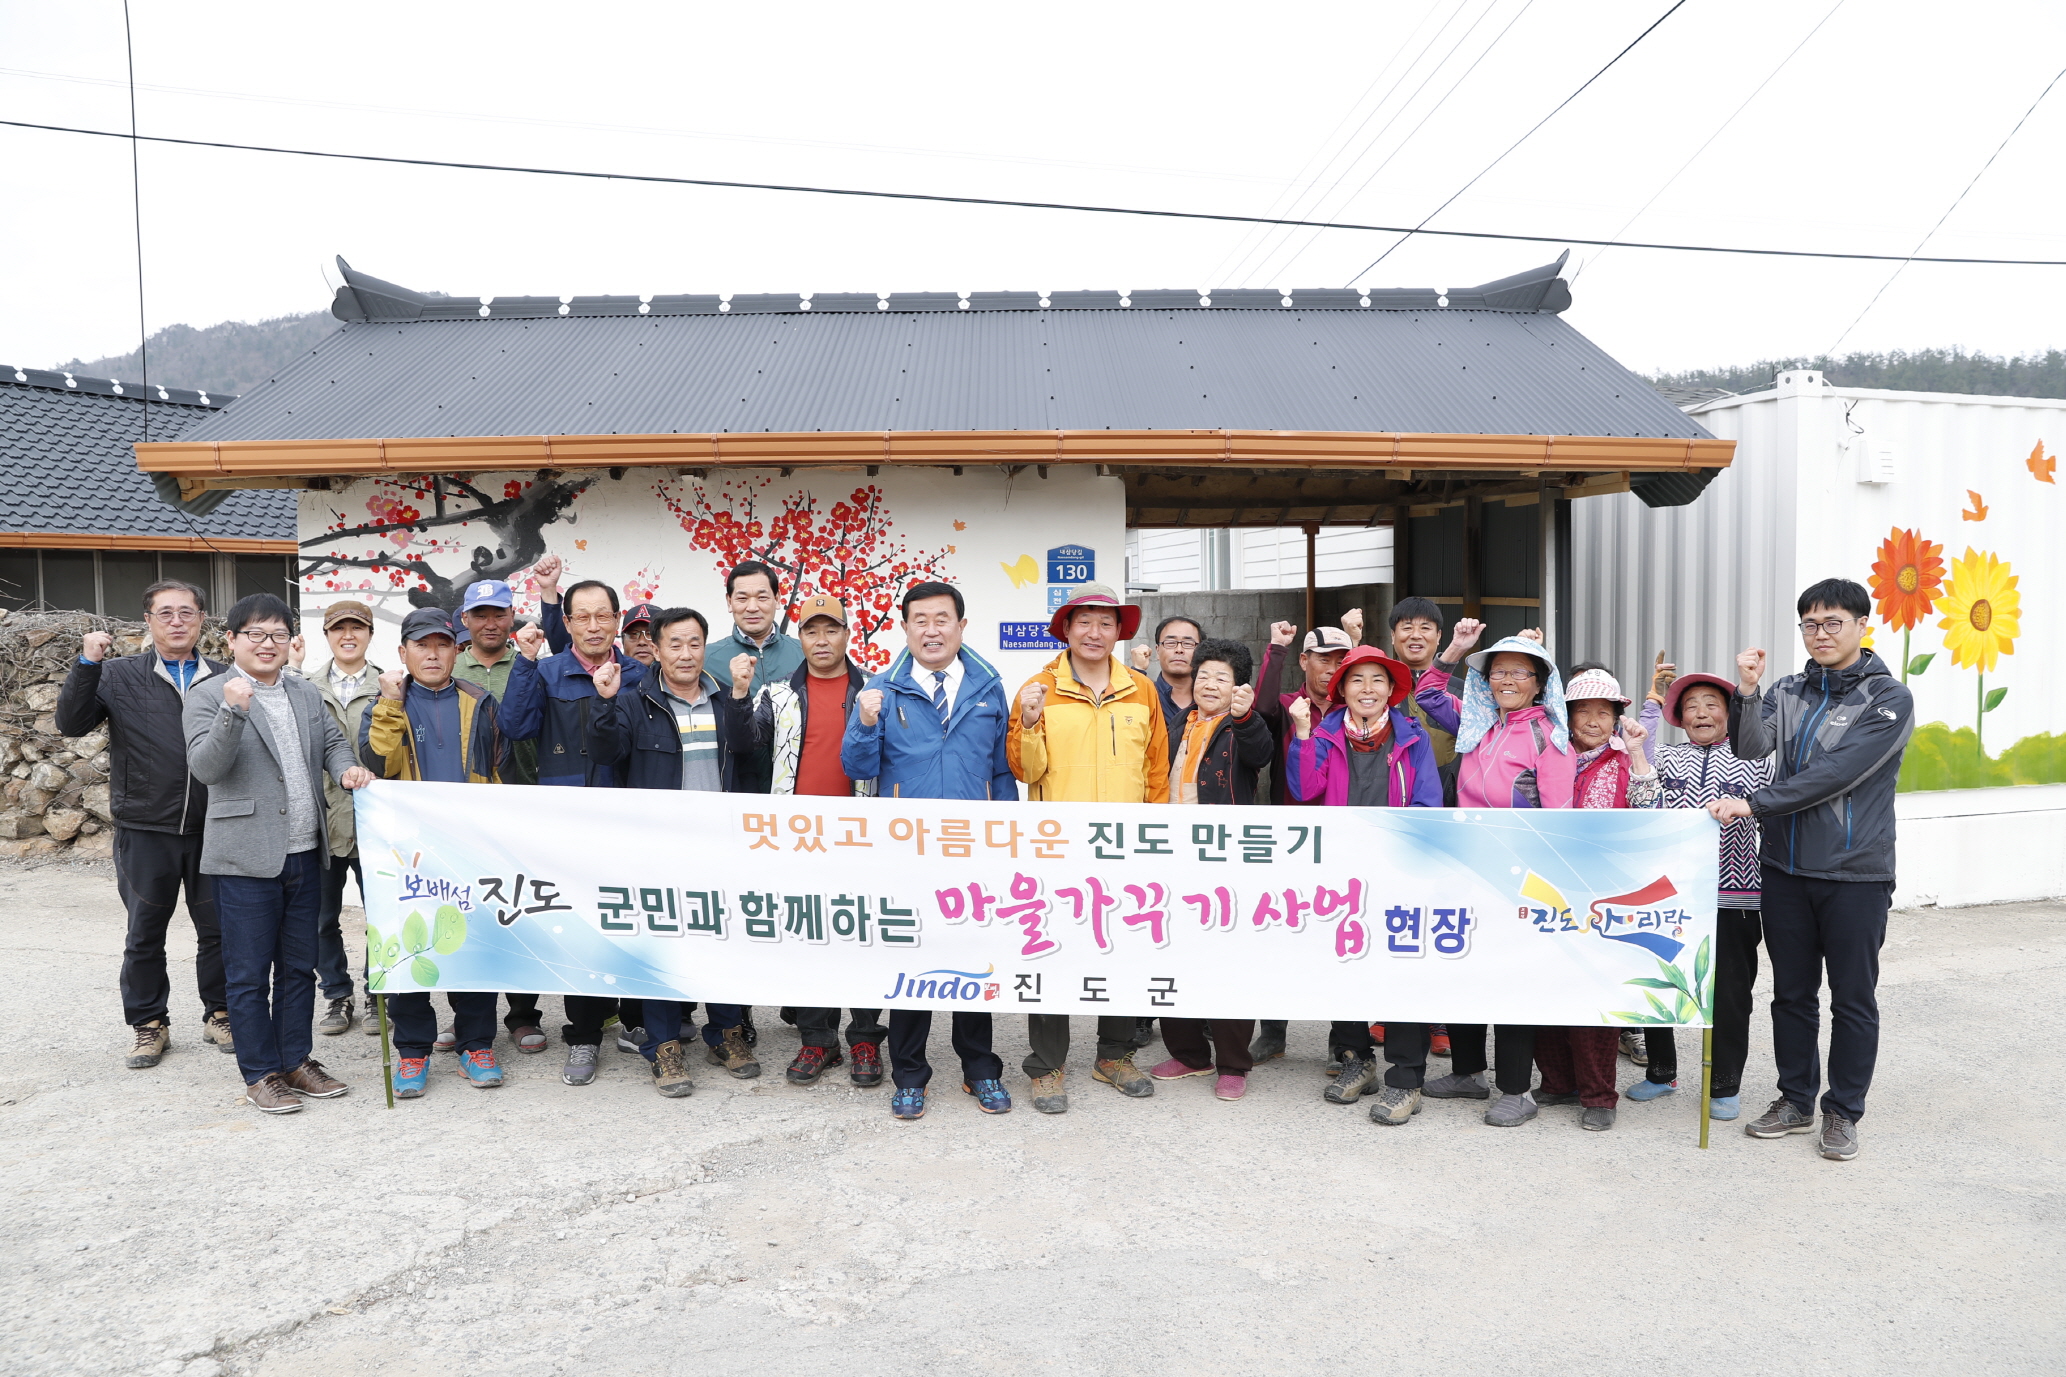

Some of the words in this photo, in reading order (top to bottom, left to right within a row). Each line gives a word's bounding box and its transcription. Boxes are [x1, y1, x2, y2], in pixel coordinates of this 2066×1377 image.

[1056, 564, 1088, 580] 130
[634, 604, 650, 618] A
[744, 813, 873, 853] 멋있고
[889, 818, 1069, 859] 아름다운
[1088, 822, 1174, 860] 진도
[1192, 824, 1322, 864] 만들기
[398, 874, 474, 911] 보배섬
[478, 873, 573, 926] 진도
[597, 886, 725, 935] 군민과
[739, 890, 916, 943] 함께하는
[1385, 905, 1471, 954] 현장
[1530, 906, 1579, 933] 진도
[884, 972, 981, 1001] Jindo
